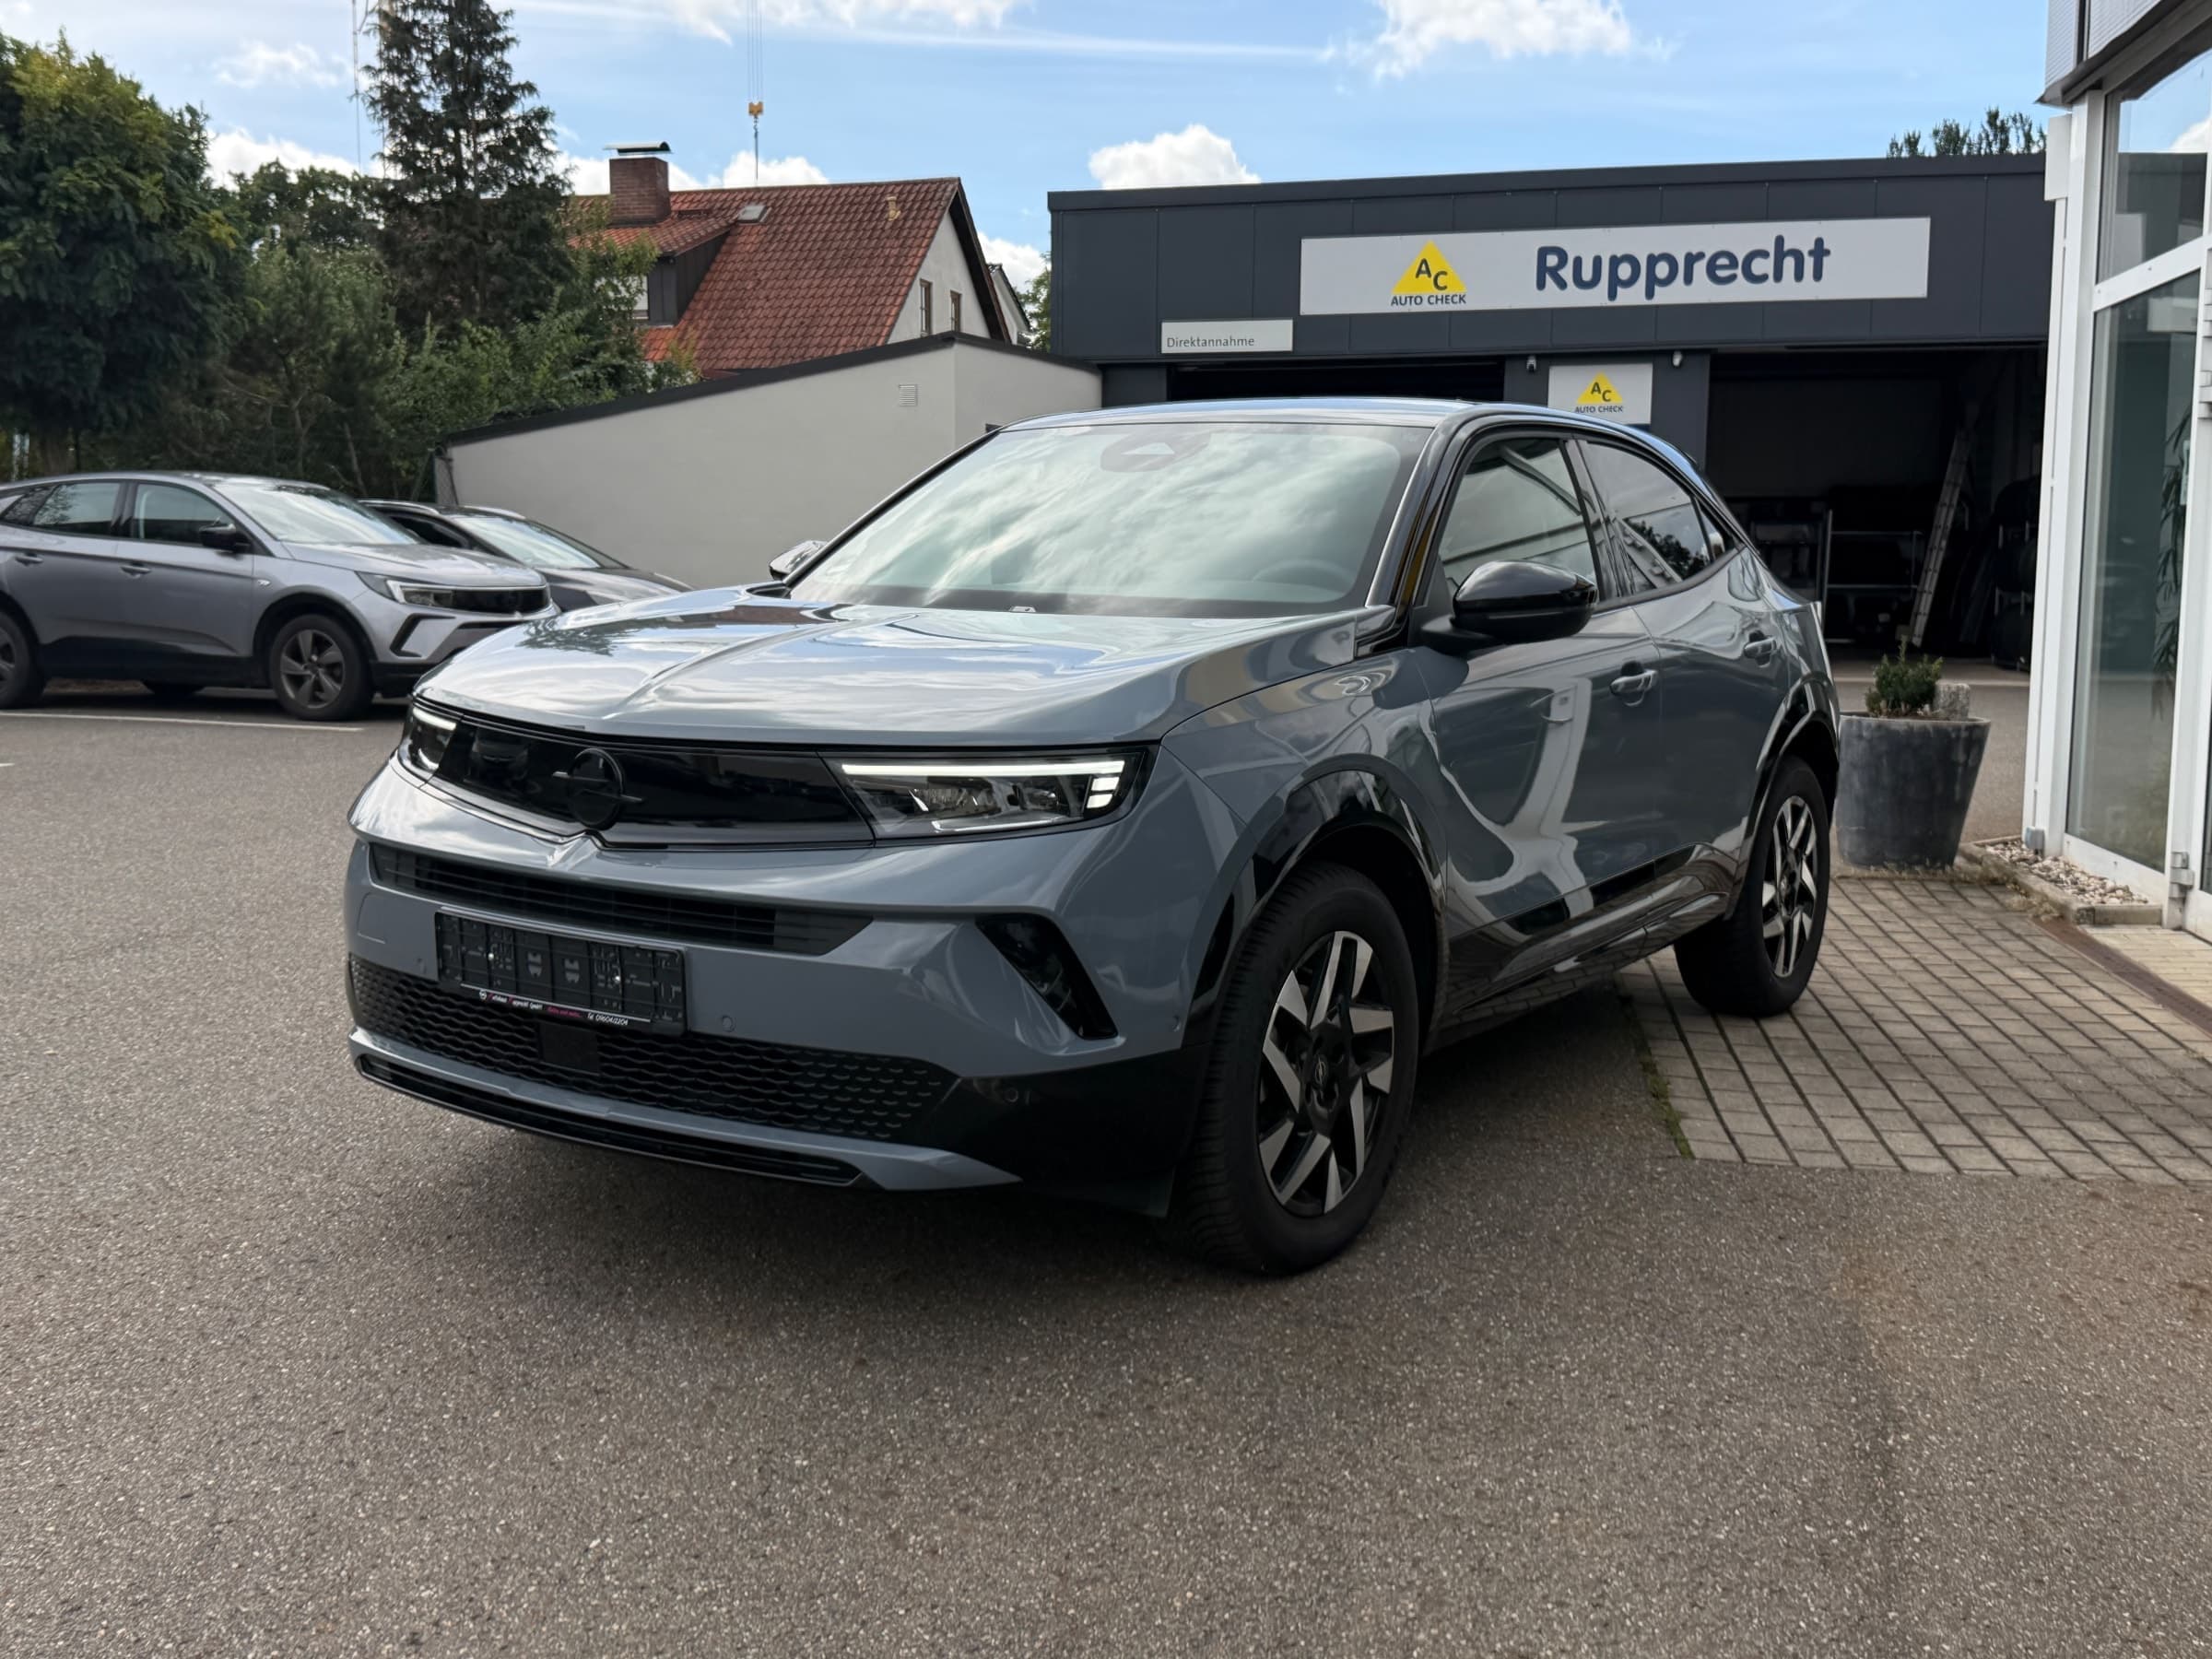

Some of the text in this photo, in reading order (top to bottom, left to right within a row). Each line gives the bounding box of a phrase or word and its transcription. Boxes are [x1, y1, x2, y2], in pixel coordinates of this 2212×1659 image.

[1535, 234, 1831, 301] Rupprecht
[1390, 293, 1467, 306] AUTO CHECK
[1166, 335, 1255, 347] Direktannahme
[1574, 405, 1624, 414] AUTO CHECK
